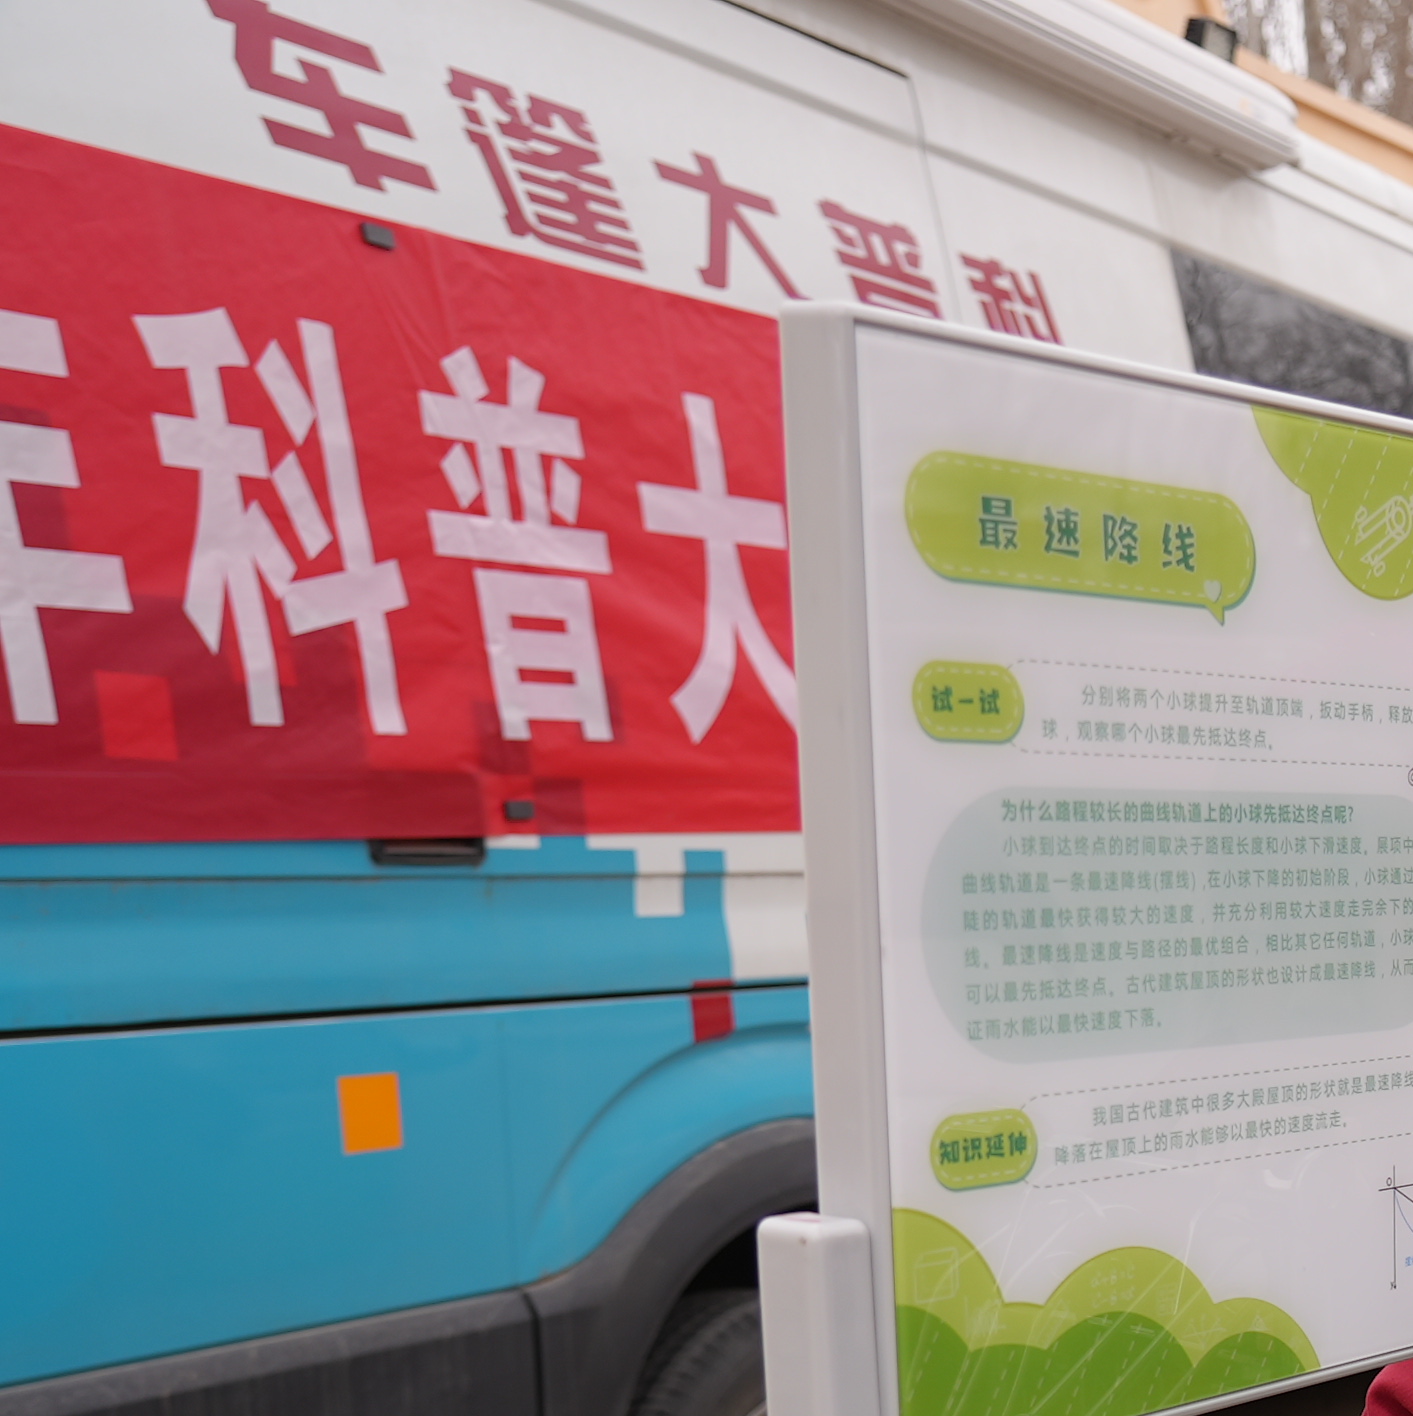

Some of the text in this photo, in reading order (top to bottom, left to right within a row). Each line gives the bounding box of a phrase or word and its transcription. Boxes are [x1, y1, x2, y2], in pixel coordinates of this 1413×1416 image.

[978, 496, 1196, 572] 最速降线
[931, 686, 1000, 715] 试一试
[1042, 718, 1274, 750] 球，观察哪个小球最先抵达终点。
[967, 1007, 1163, 1041] 证雨水能以最快速度下落。
[938, 1132, 1028, 1165] 知识延伸
